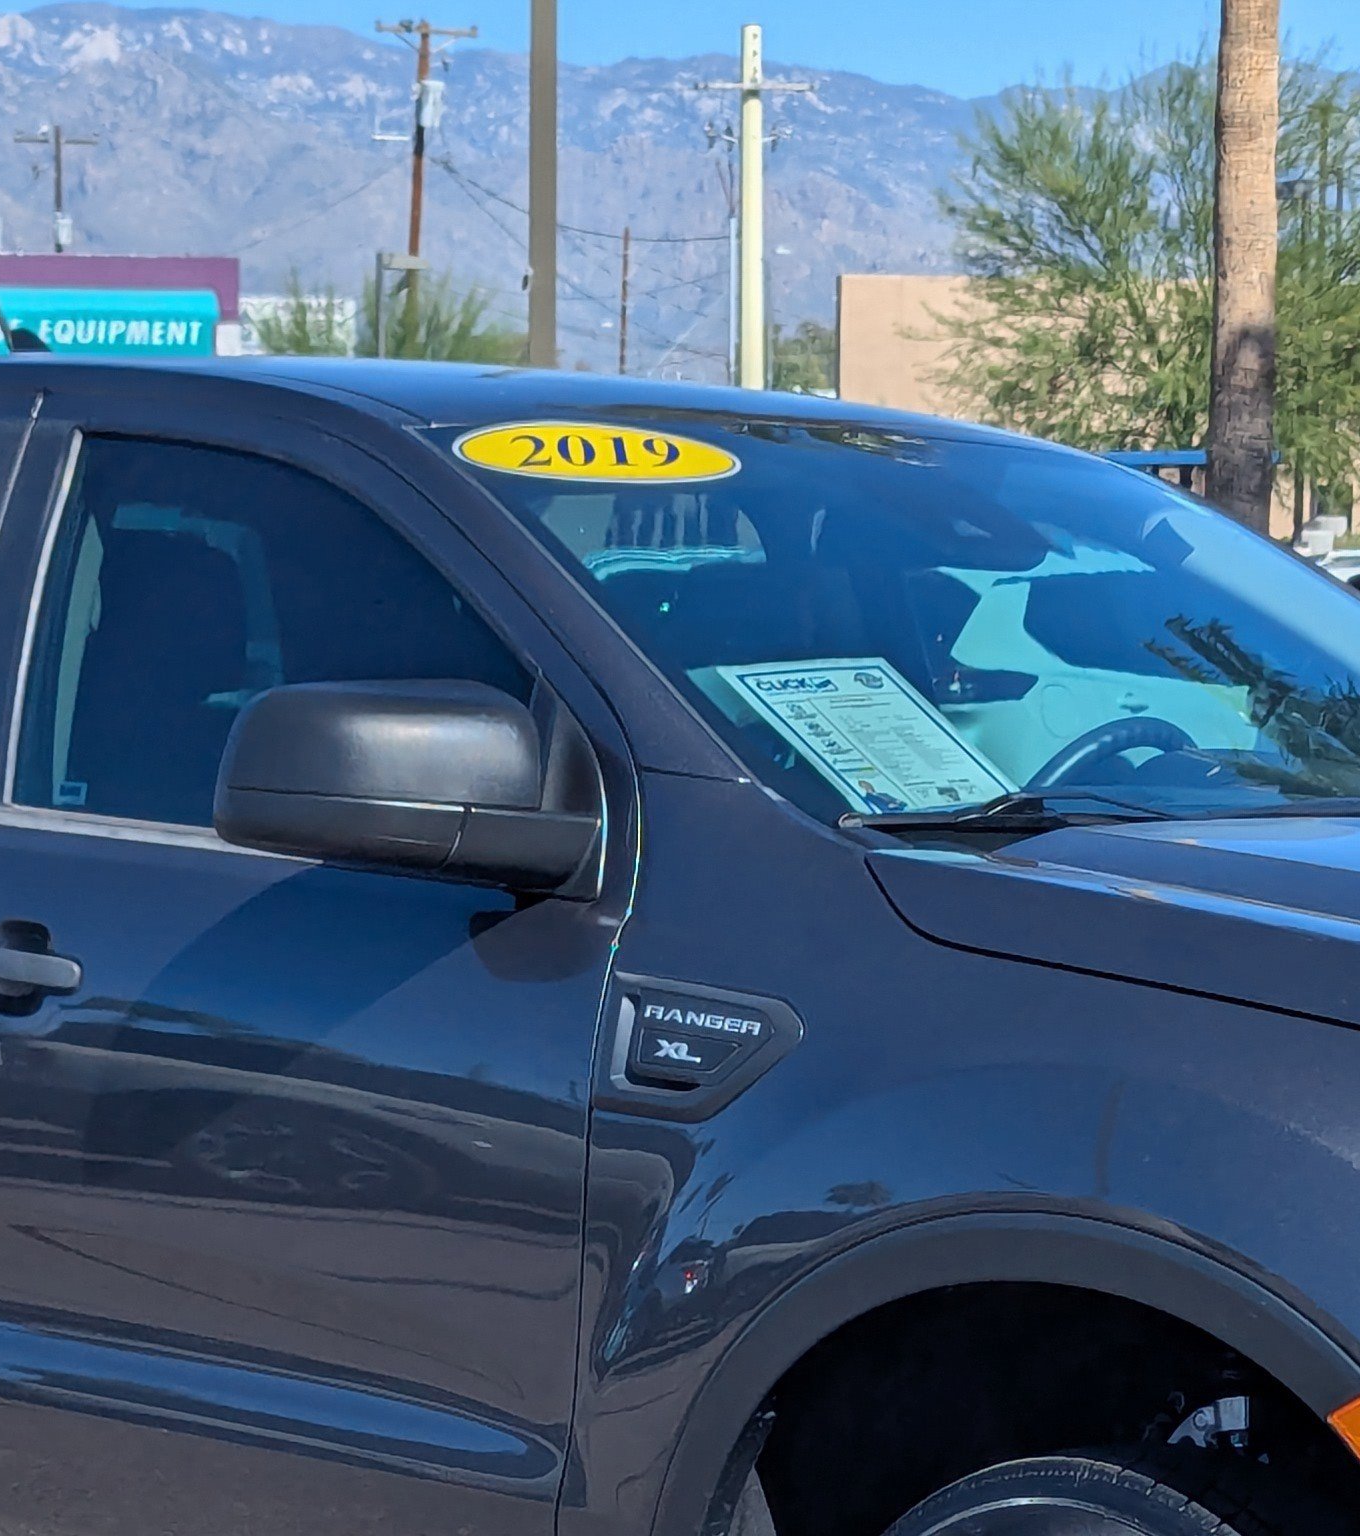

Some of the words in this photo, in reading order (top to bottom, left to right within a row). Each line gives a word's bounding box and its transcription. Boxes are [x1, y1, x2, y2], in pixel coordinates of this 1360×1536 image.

[40, 317, 204, 346] EQUIPMENT
[509, 433, 681, 468] 2019
[643, 1004, 763, 1037] RANGER
[653, 1038, 702, 1064] XL
